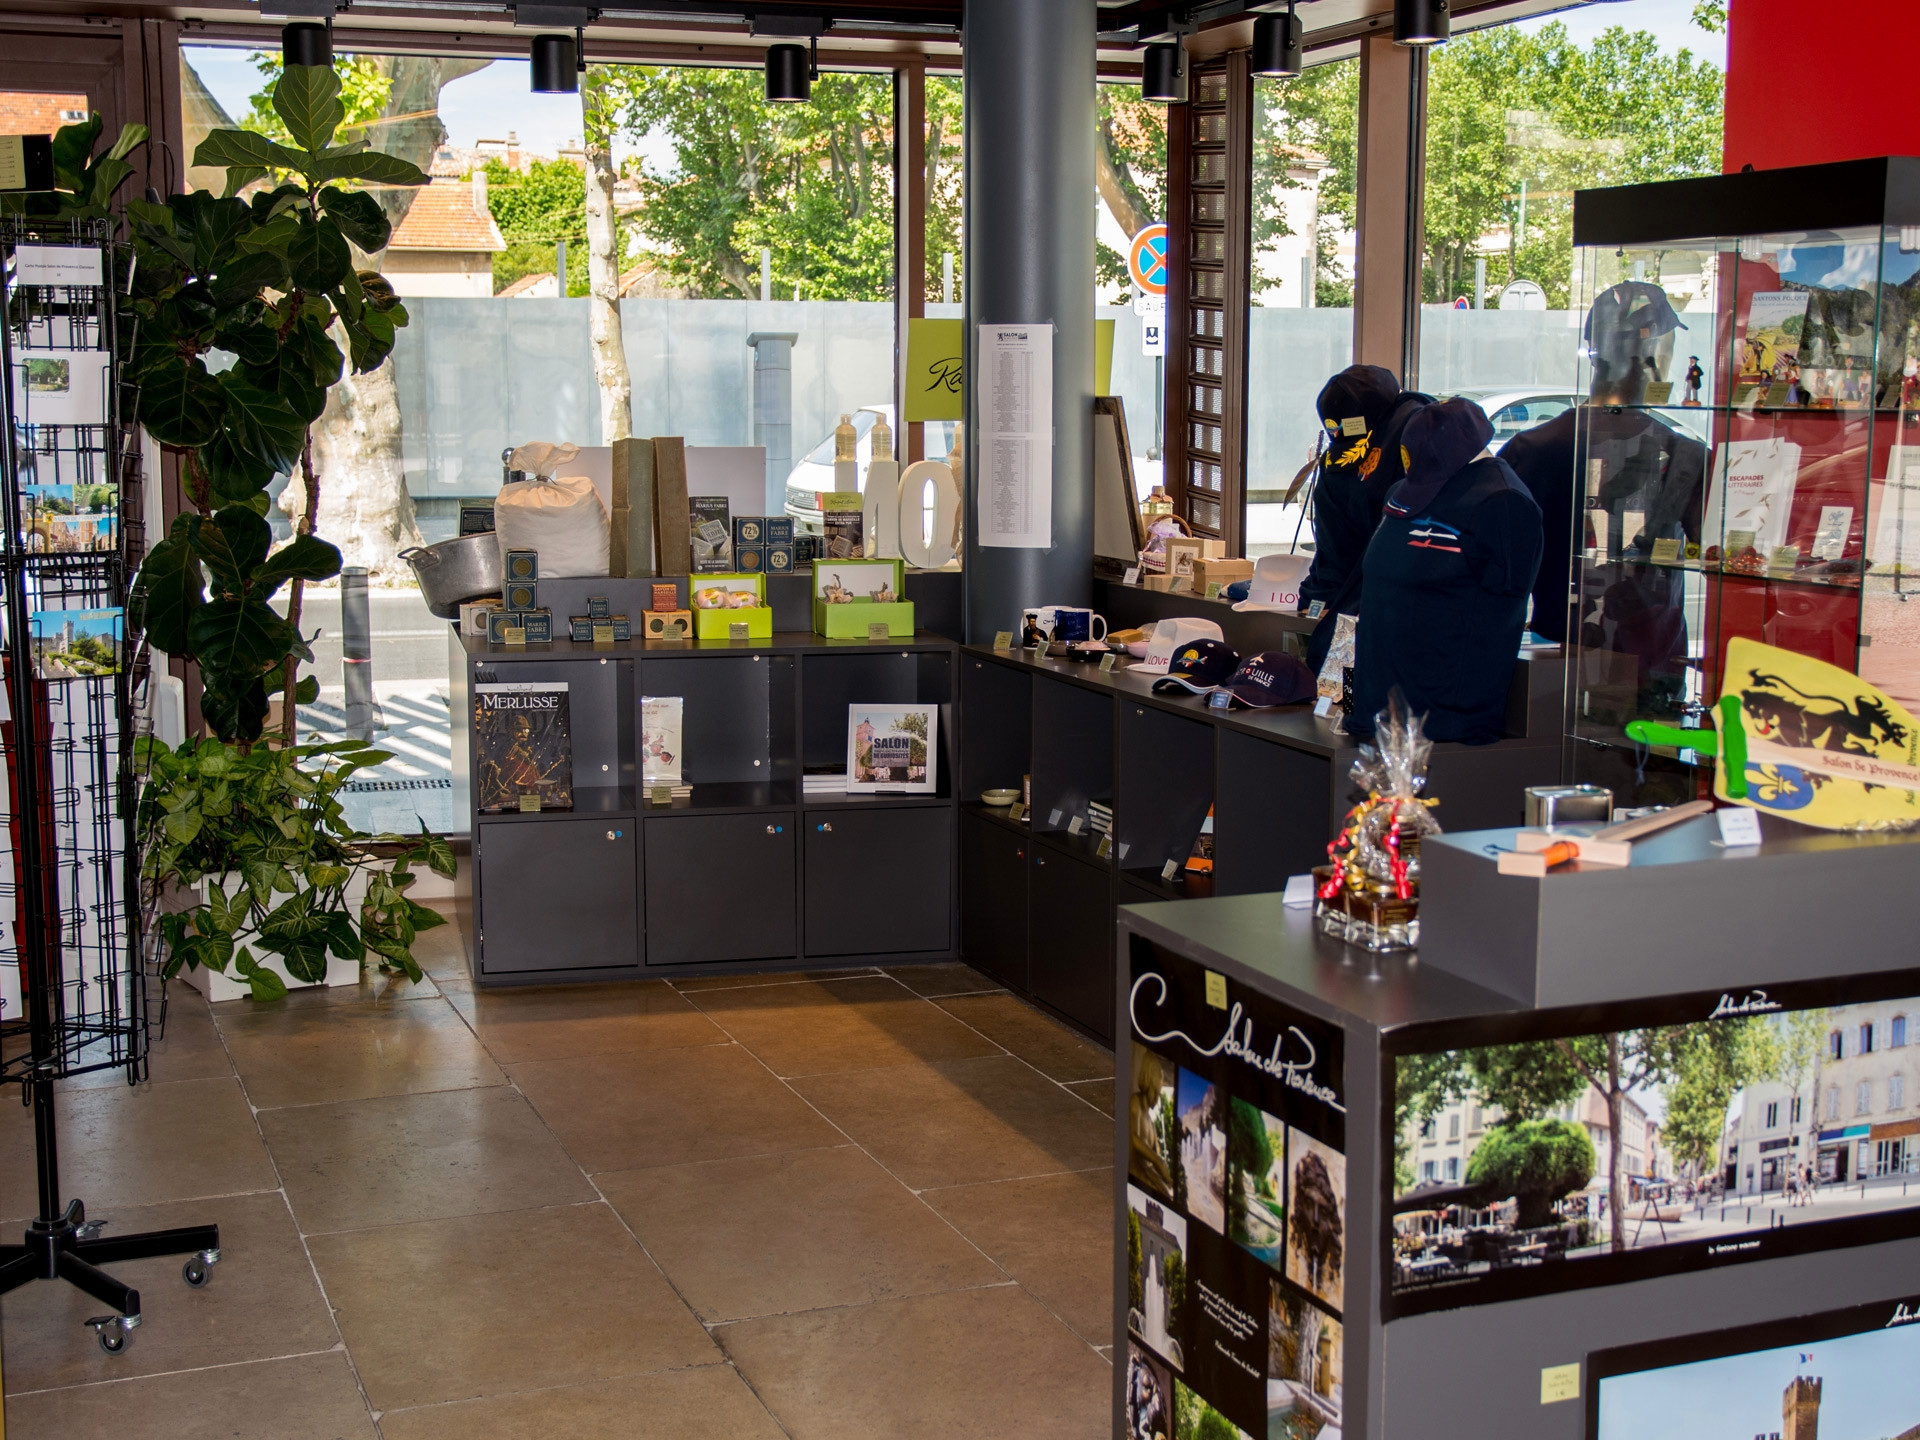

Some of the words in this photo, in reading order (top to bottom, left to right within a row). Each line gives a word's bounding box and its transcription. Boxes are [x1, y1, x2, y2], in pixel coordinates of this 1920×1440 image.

[482, 694, 559, 710] MERLUSSE
[873, 738, 909, 749] SALON
[1822, 755, 1852, 769] Salon
[1854, 759, 1866, 772] de
[1868, 763, 1918, 781] Provence
